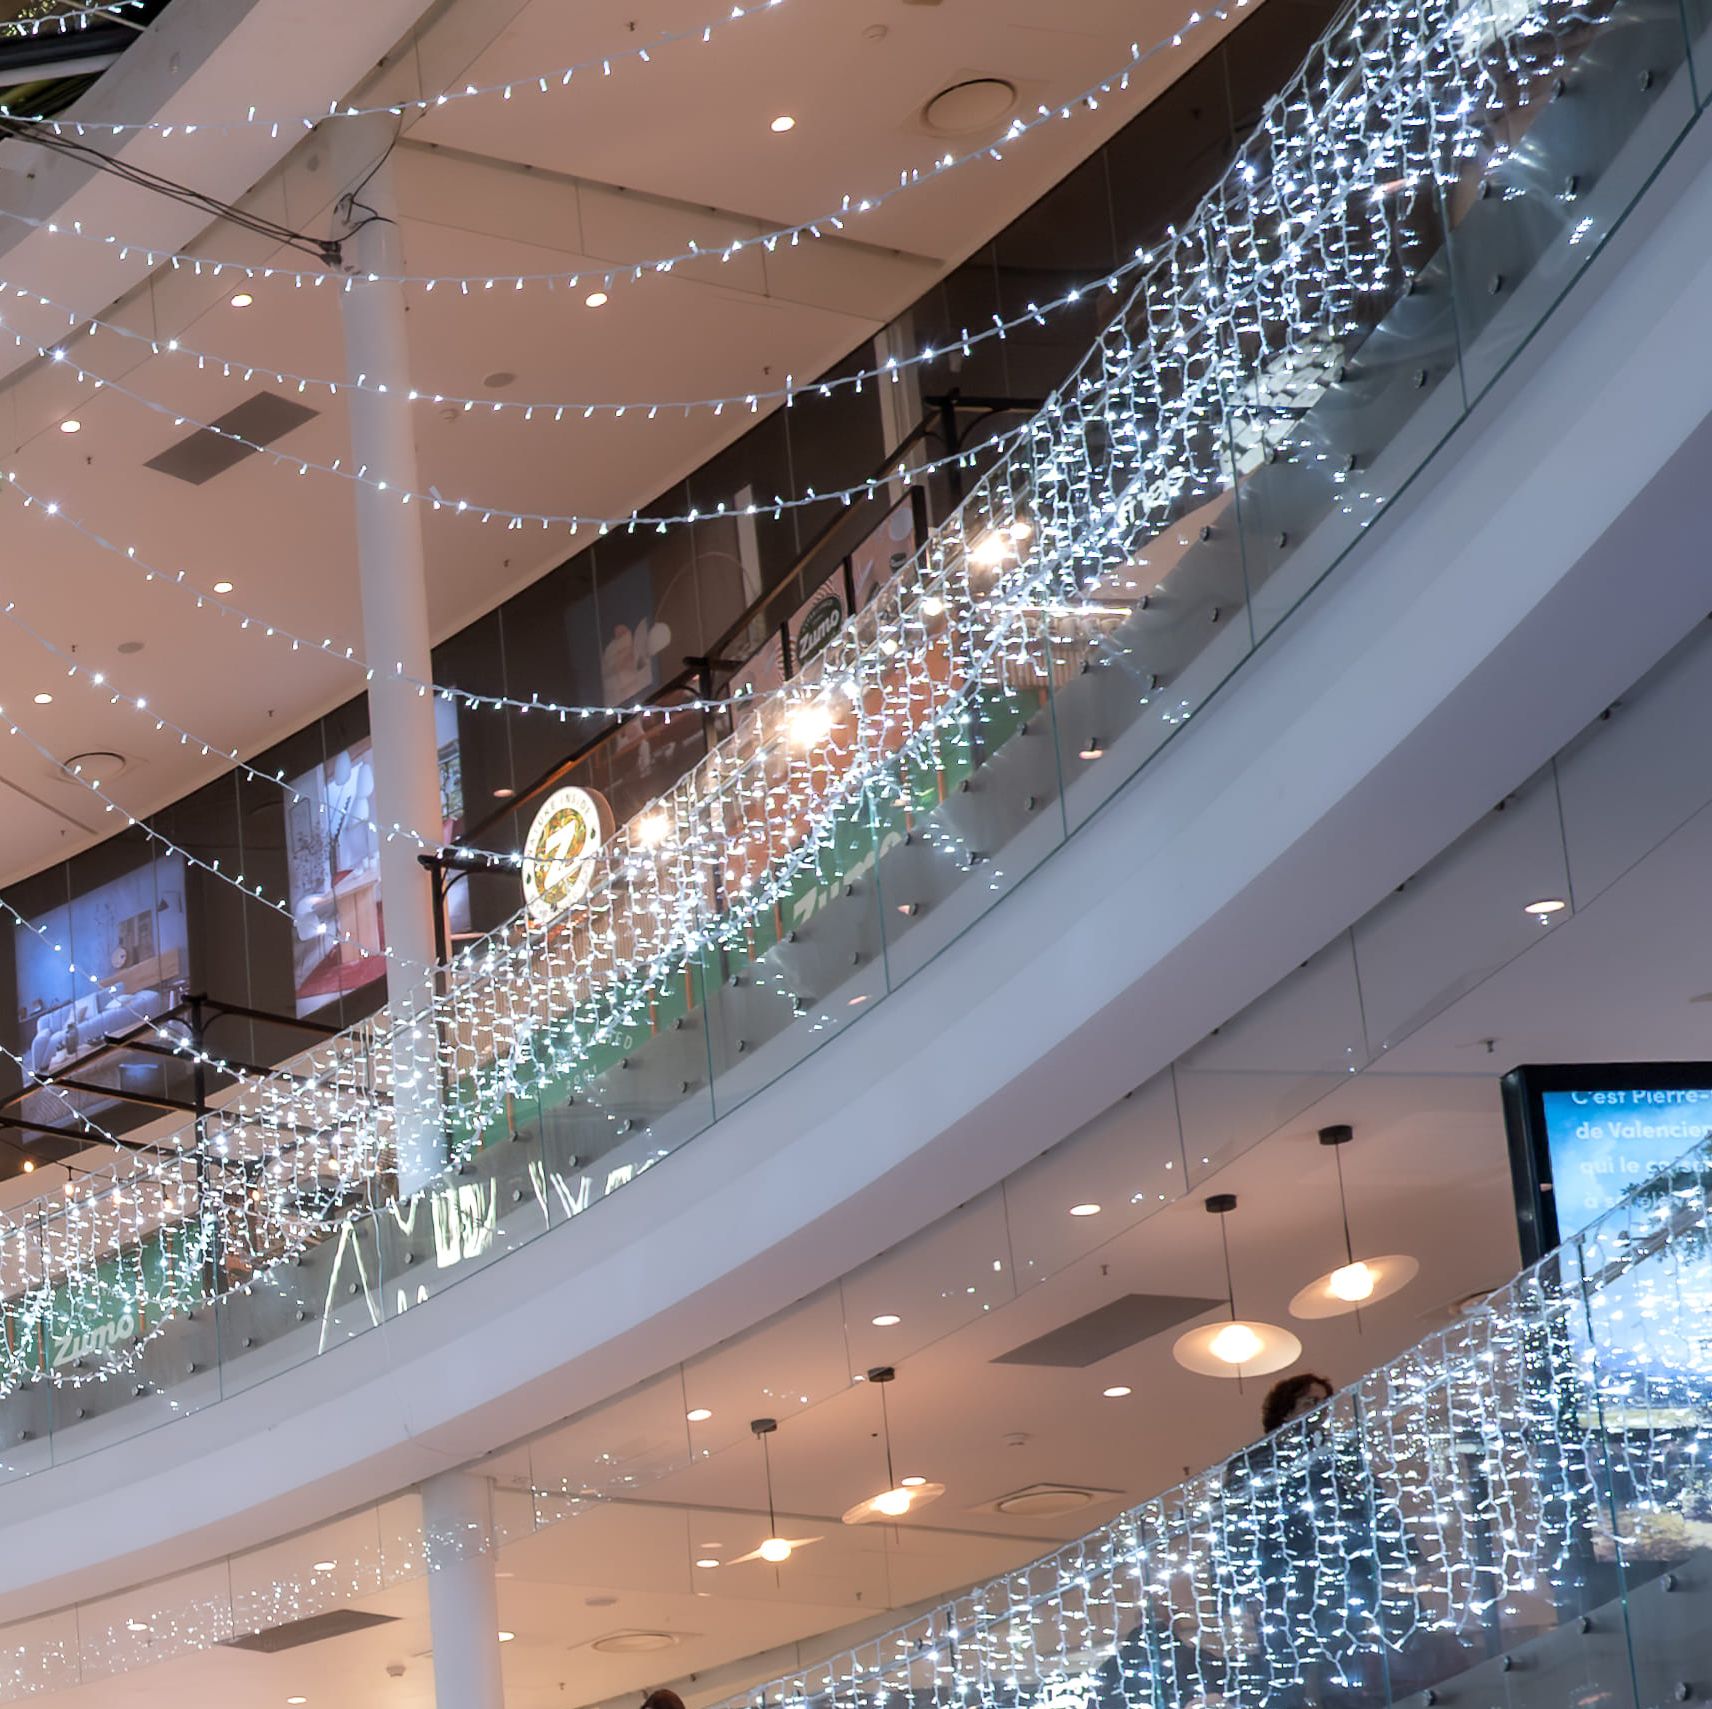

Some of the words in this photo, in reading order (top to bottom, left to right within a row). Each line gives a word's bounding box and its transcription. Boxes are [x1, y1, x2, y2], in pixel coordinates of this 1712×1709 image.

[1632, 1090, 1712, 1104] Pierre-
[1576, 1122, 1604, 1139] de
[1580, 1157, 1615, 1178] qui
[1620, 1157, 1640, 1174] le
